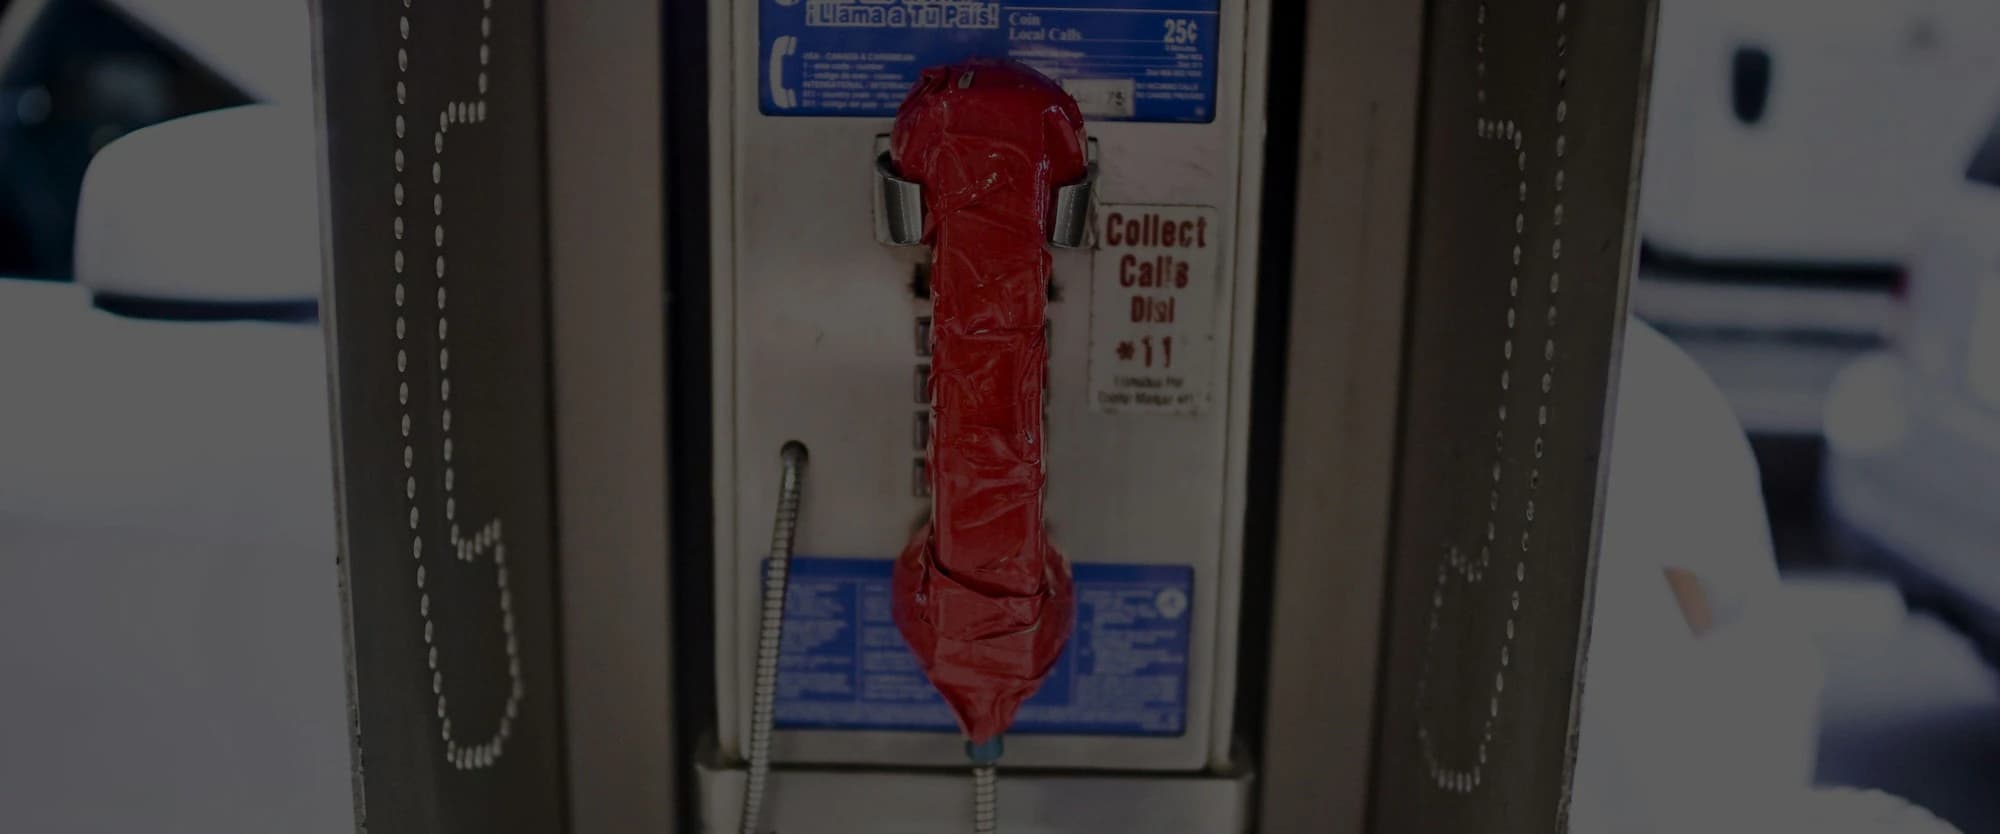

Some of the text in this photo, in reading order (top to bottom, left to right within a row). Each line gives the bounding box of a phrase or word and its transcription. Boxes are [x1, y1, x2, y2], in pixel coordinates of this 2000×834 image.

[888, 8, 901, 25] a
[912, 5, 938, 25] Tu
[1008, 12, 1040, 26] Coin
[1009, 27, 1083, 41] Local Calls
[1164, 19, 1198, 44] 25¢
[1106, 213, 1206, 247] Collect
[1119, 254, 1189, 289] Calls
